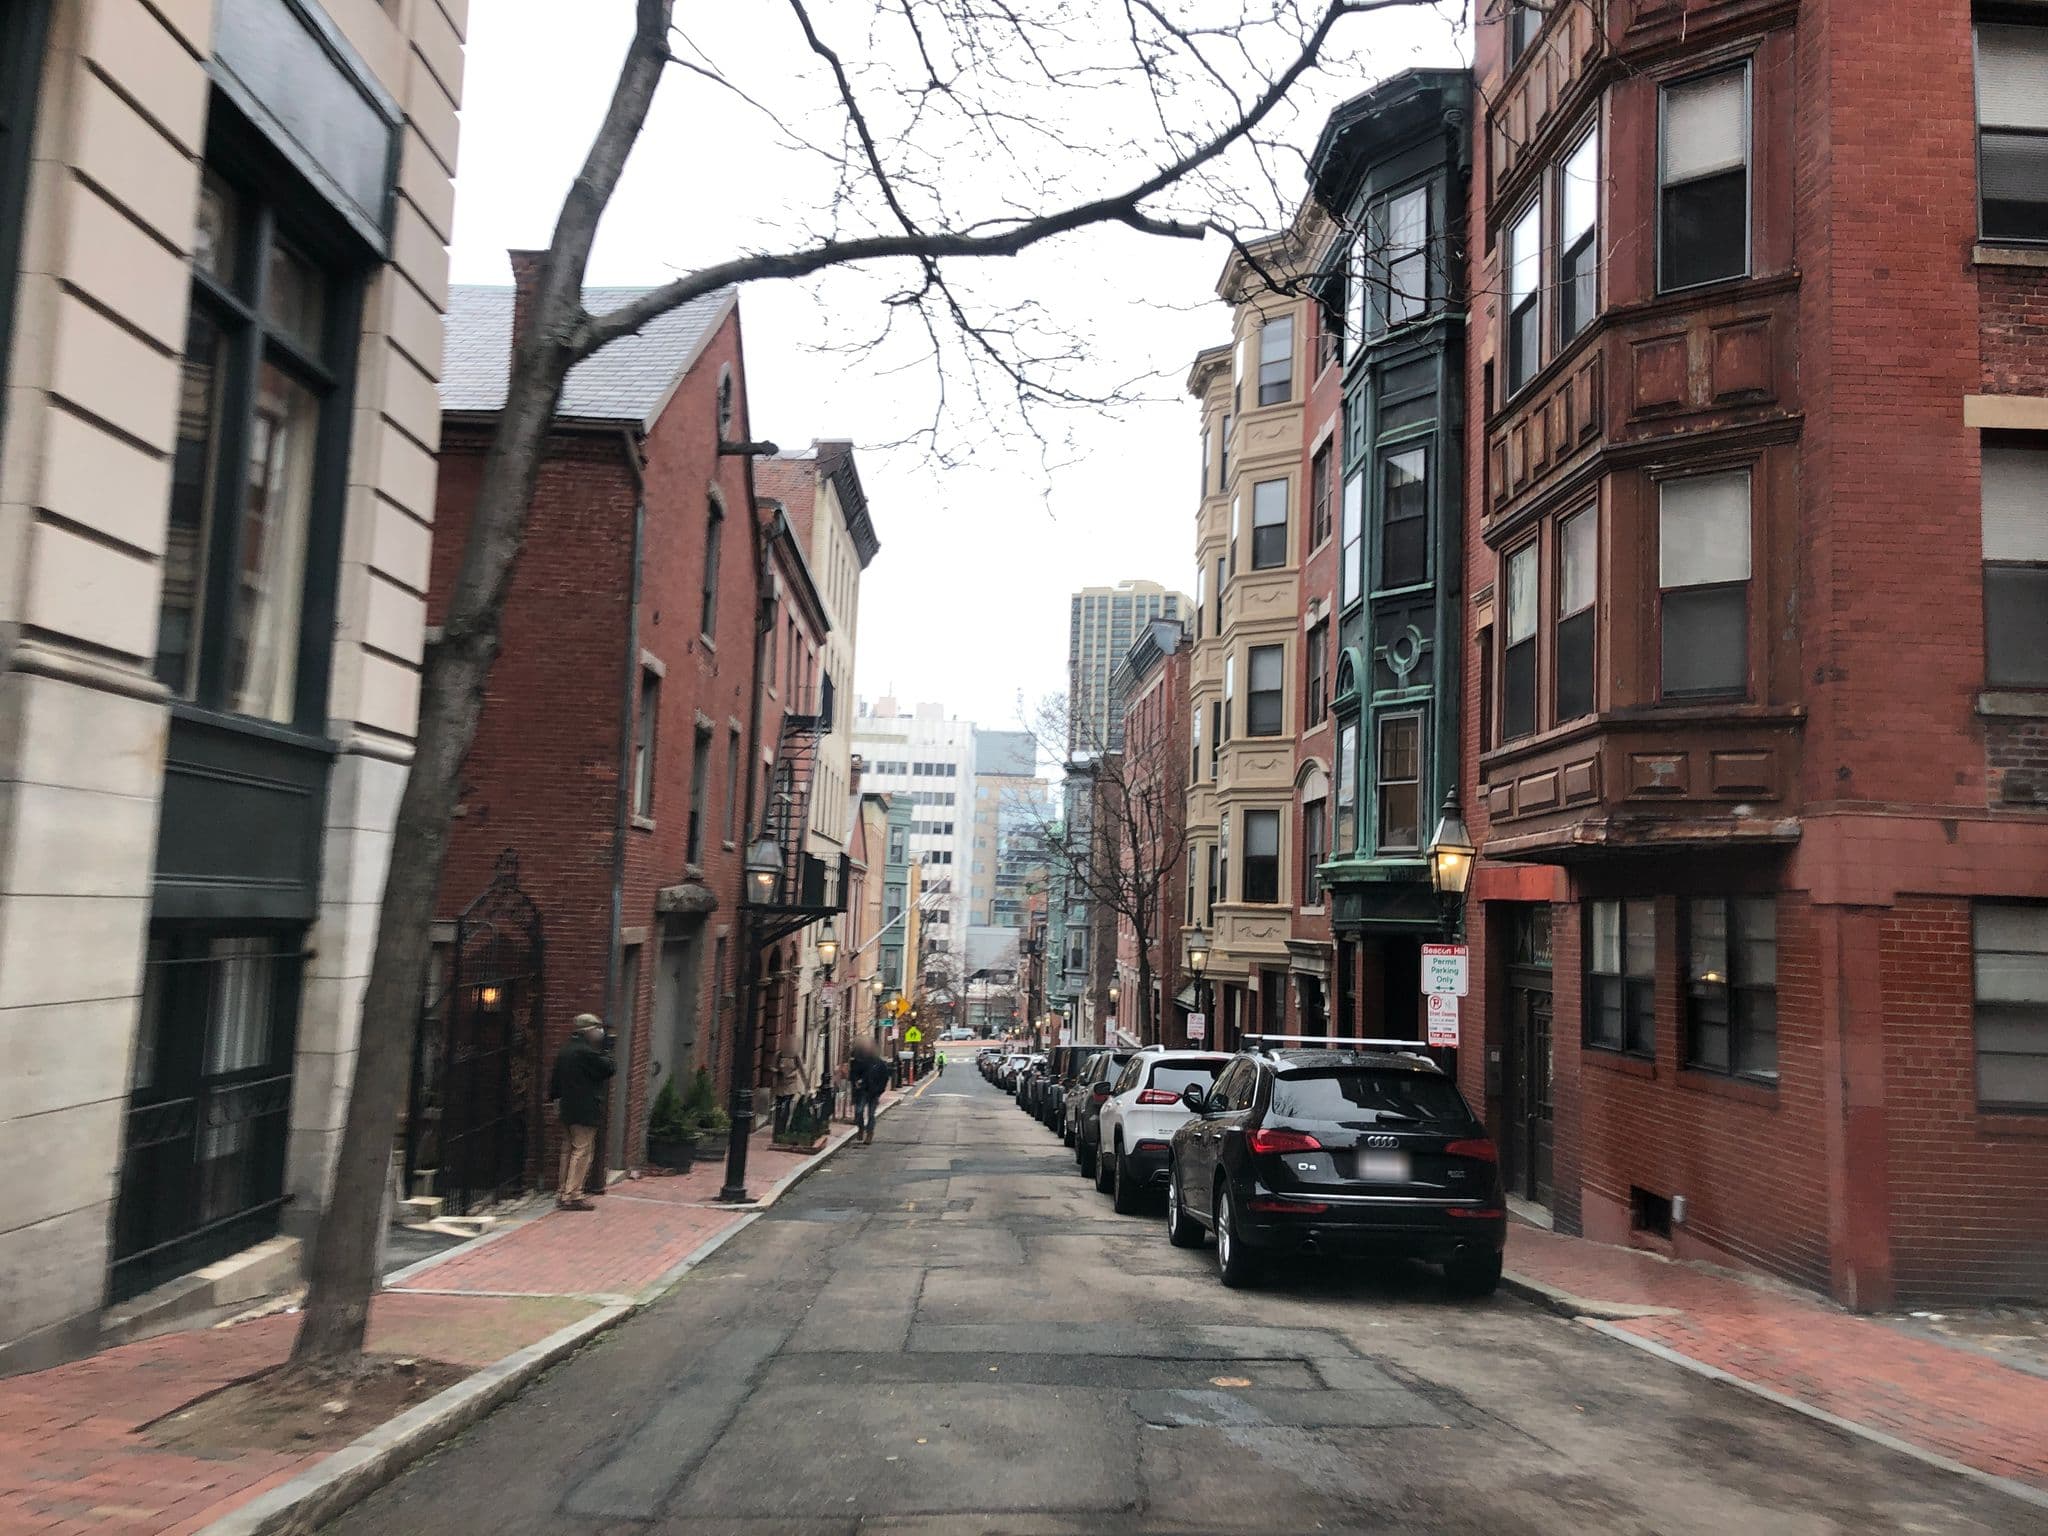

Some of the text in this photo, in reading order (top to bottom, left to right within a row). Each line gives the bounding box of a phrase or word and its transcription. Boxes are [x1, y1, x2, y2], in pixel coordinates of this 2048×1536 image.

[1423, 947, 1452, 955] Beacon
[1431, 967, 1459, 975] Parking
[1436, 976, 1454, 984] Only
